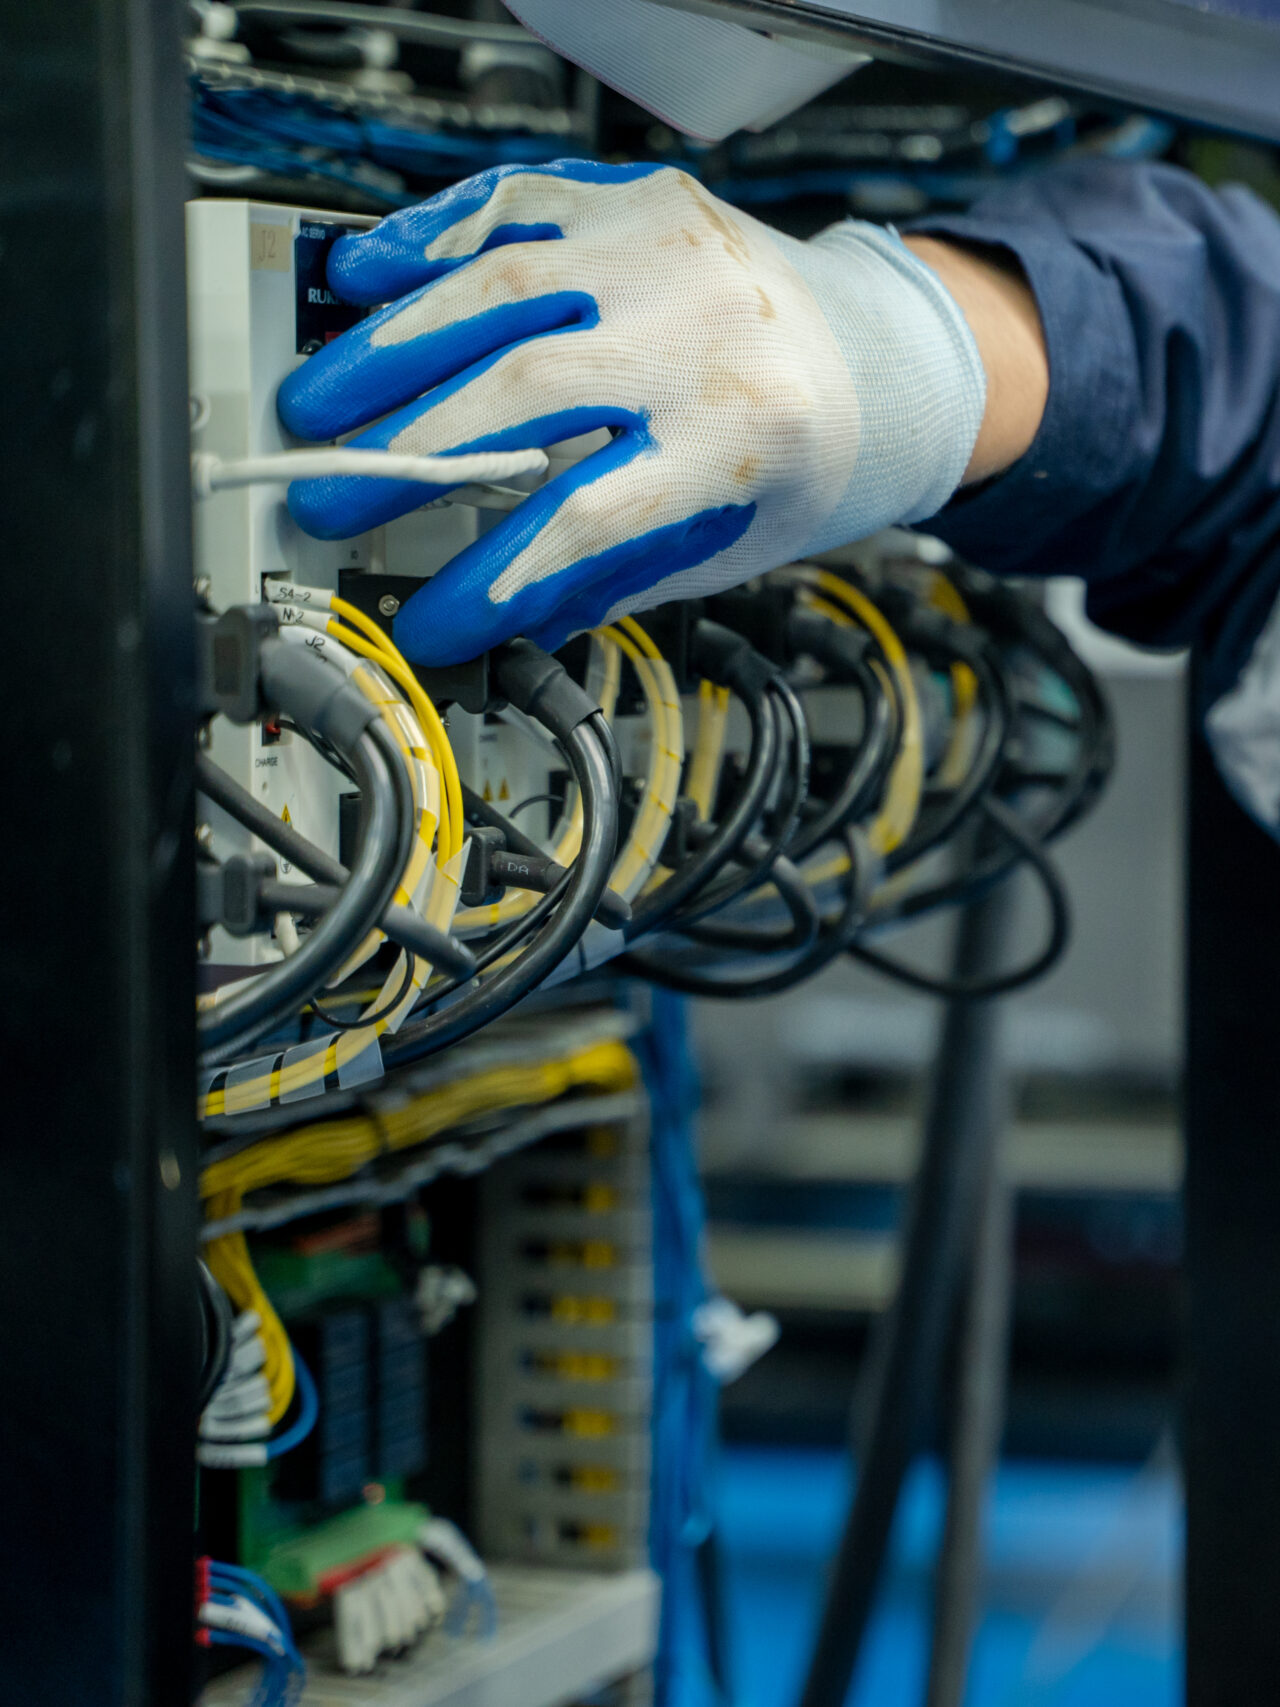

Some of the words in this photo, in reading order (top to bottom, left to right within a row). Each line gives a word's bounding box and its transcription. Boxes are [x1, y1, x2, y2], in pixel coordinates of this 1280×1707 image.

[279, 587, 312, 602] S4-2
[305, 635, 326, 653] J2
[255, 756, 278, 768] CHARGE
